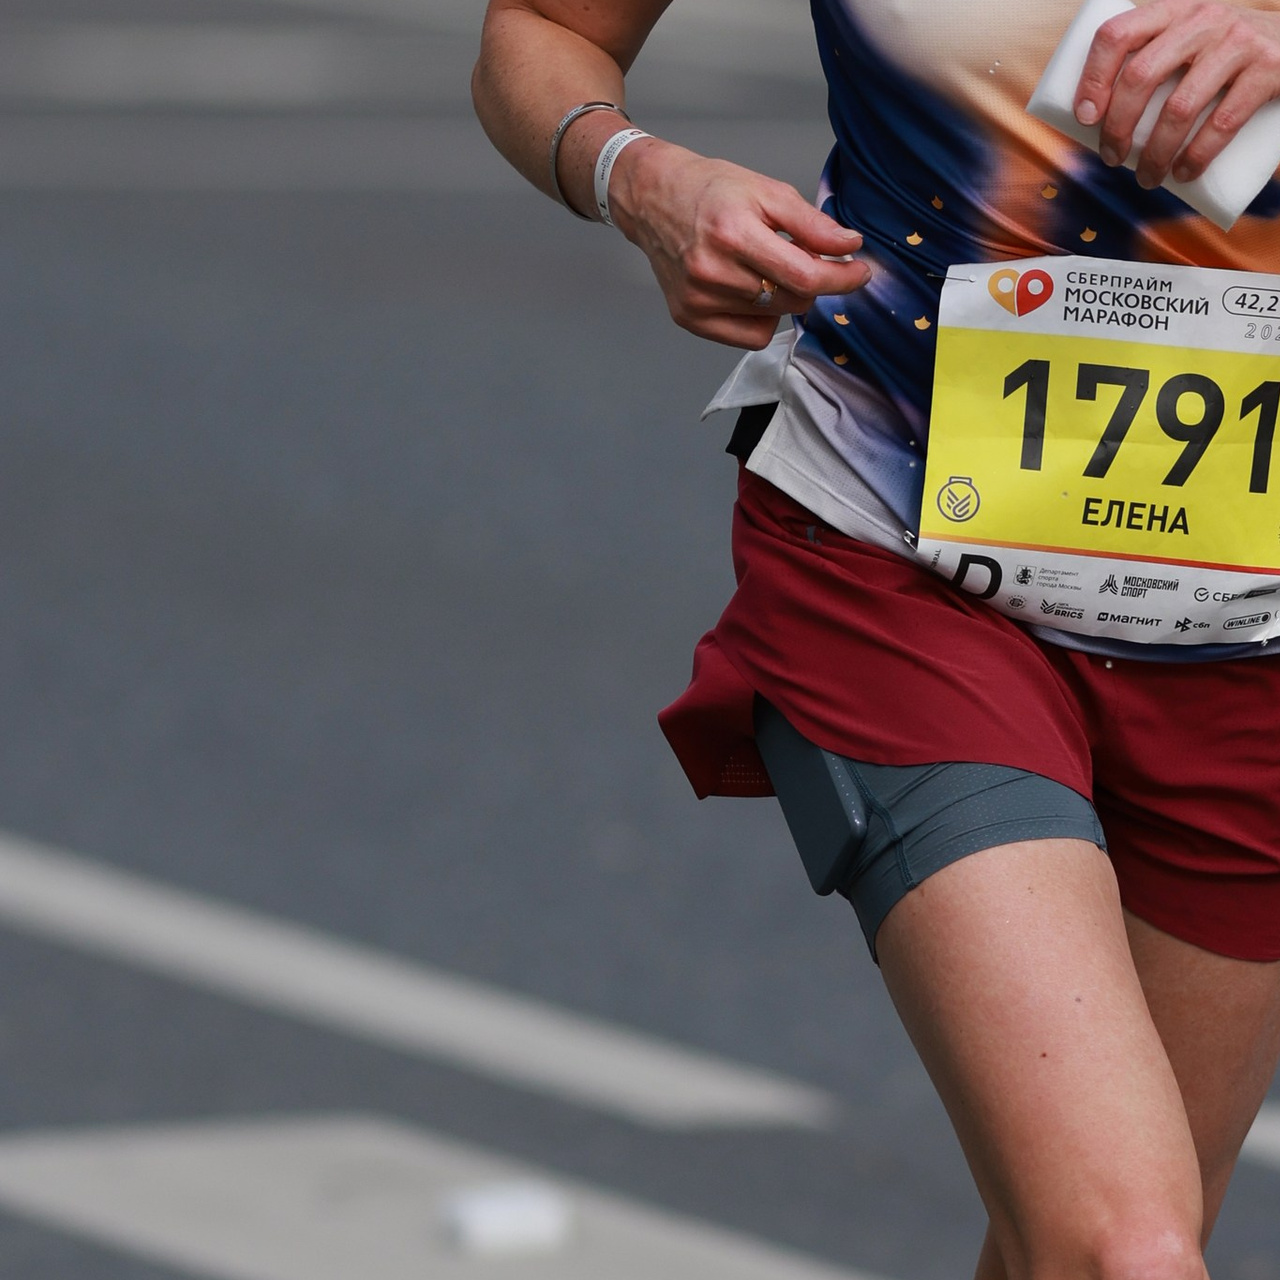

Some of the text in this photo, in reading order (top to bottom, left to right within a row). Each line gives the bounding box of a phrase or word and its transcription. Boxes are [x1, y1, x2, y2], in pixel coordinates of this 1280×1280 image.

[1066, 271, 1173, 293] СБЕРПРАЙМ
[1065, 287, 1210, 316] МОСКОВСКИЙ
[1234, 293, 1279, 313] 42,2
[1063, 306, 1169, 331] МАРАФОН
[1081, 497, 1189, 535] ЕЛЕНА
[953, 553, 1003, 600] D
[1039, 568, 1079, 576] Департамент
[1121, 586, 1148, 599] СПОРТ
[1123, 575, 1179, 591] МОСКОВСКИЙ
[1054, 609, 1084, 620] BRICS
[1227, 615, 1261, 628] WINLINE
